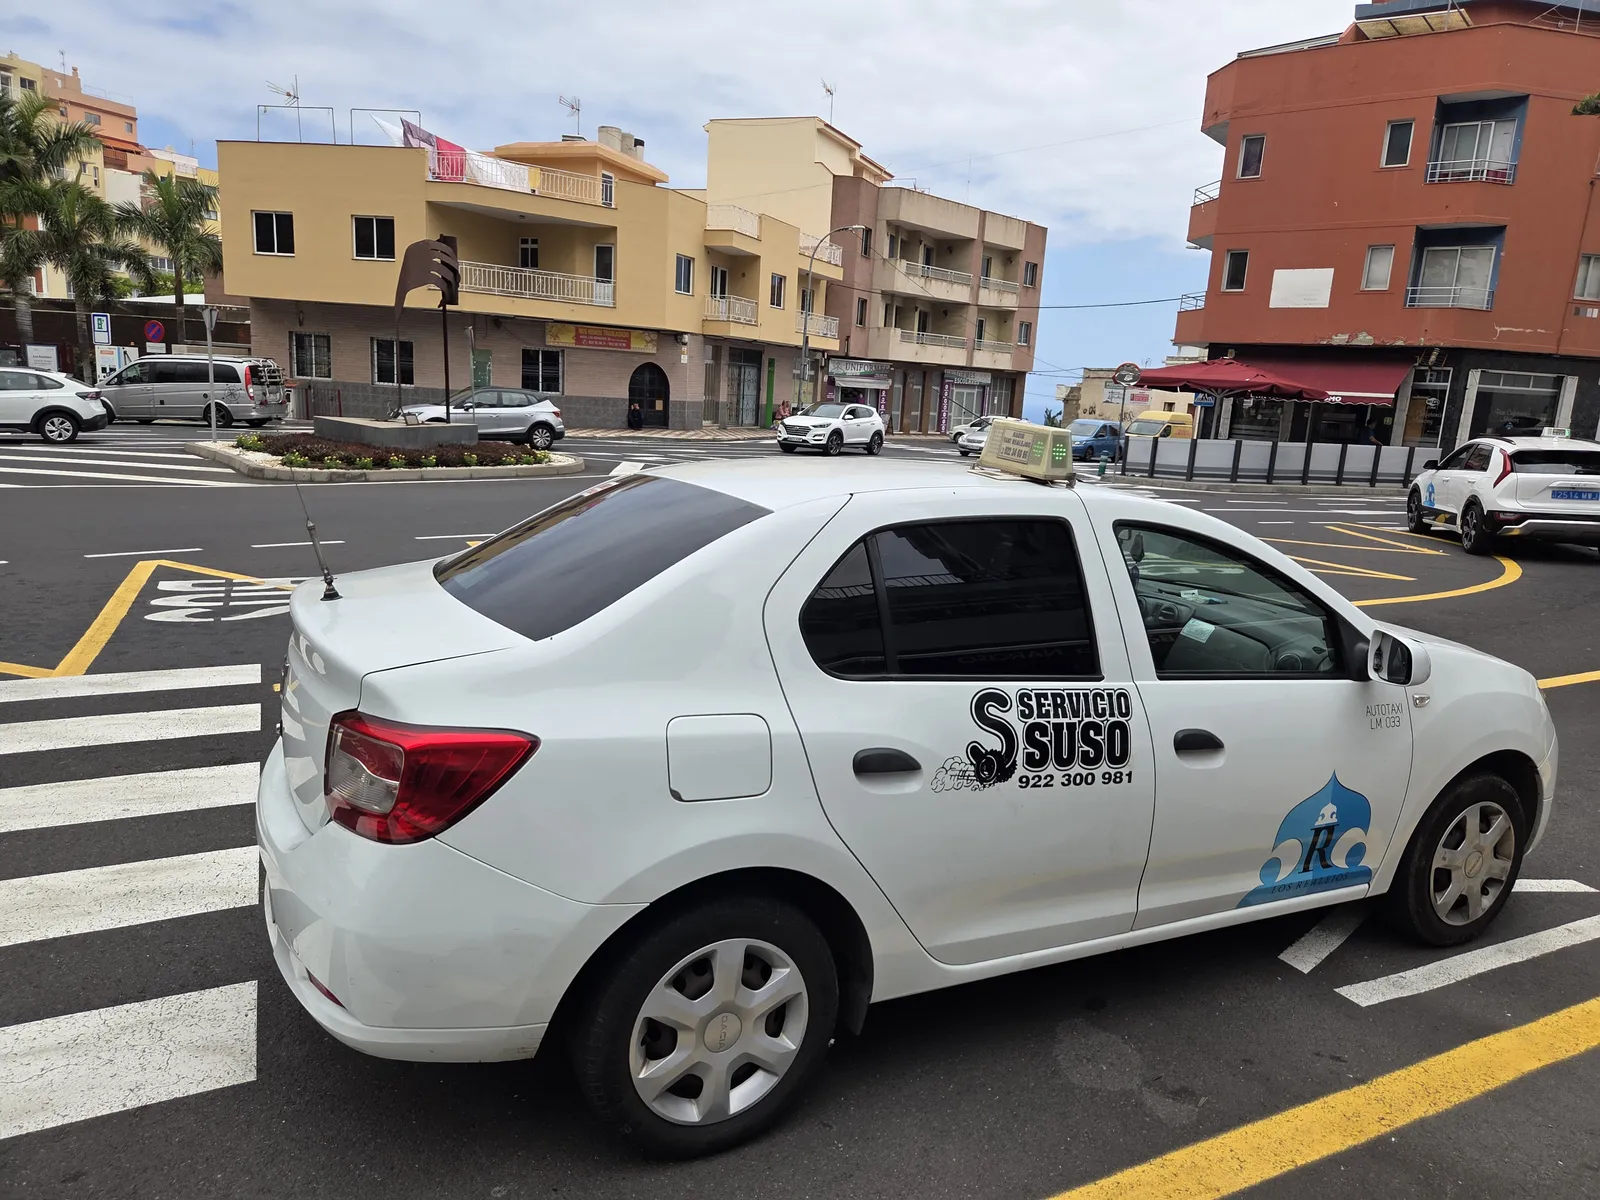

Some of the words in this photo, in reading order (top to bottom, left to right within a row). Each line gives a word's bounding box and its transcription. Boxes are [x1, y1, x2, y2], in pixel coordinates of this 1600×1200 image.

[845, 362, 890, 373] UNIFORMES
[1557, 491, 1579, 499] 2514
[1016, 687, 1133, 722] SERVICIO
[1365, 702, 1404, 717] AUTOTAXI
[1370, 717, 1383, 730] LM
[1385, 716, 1401, 728] 033
[1022, 719, 1132, 772] SUSO
[1018, 774, 1054, 789] 922
[1060, 772, 1096, 787] 300
[1101, 770, 1133, 785] 981
[1271, 882, 1293, 895] LOS
[718, 1015, 729, 1050] DACIA
